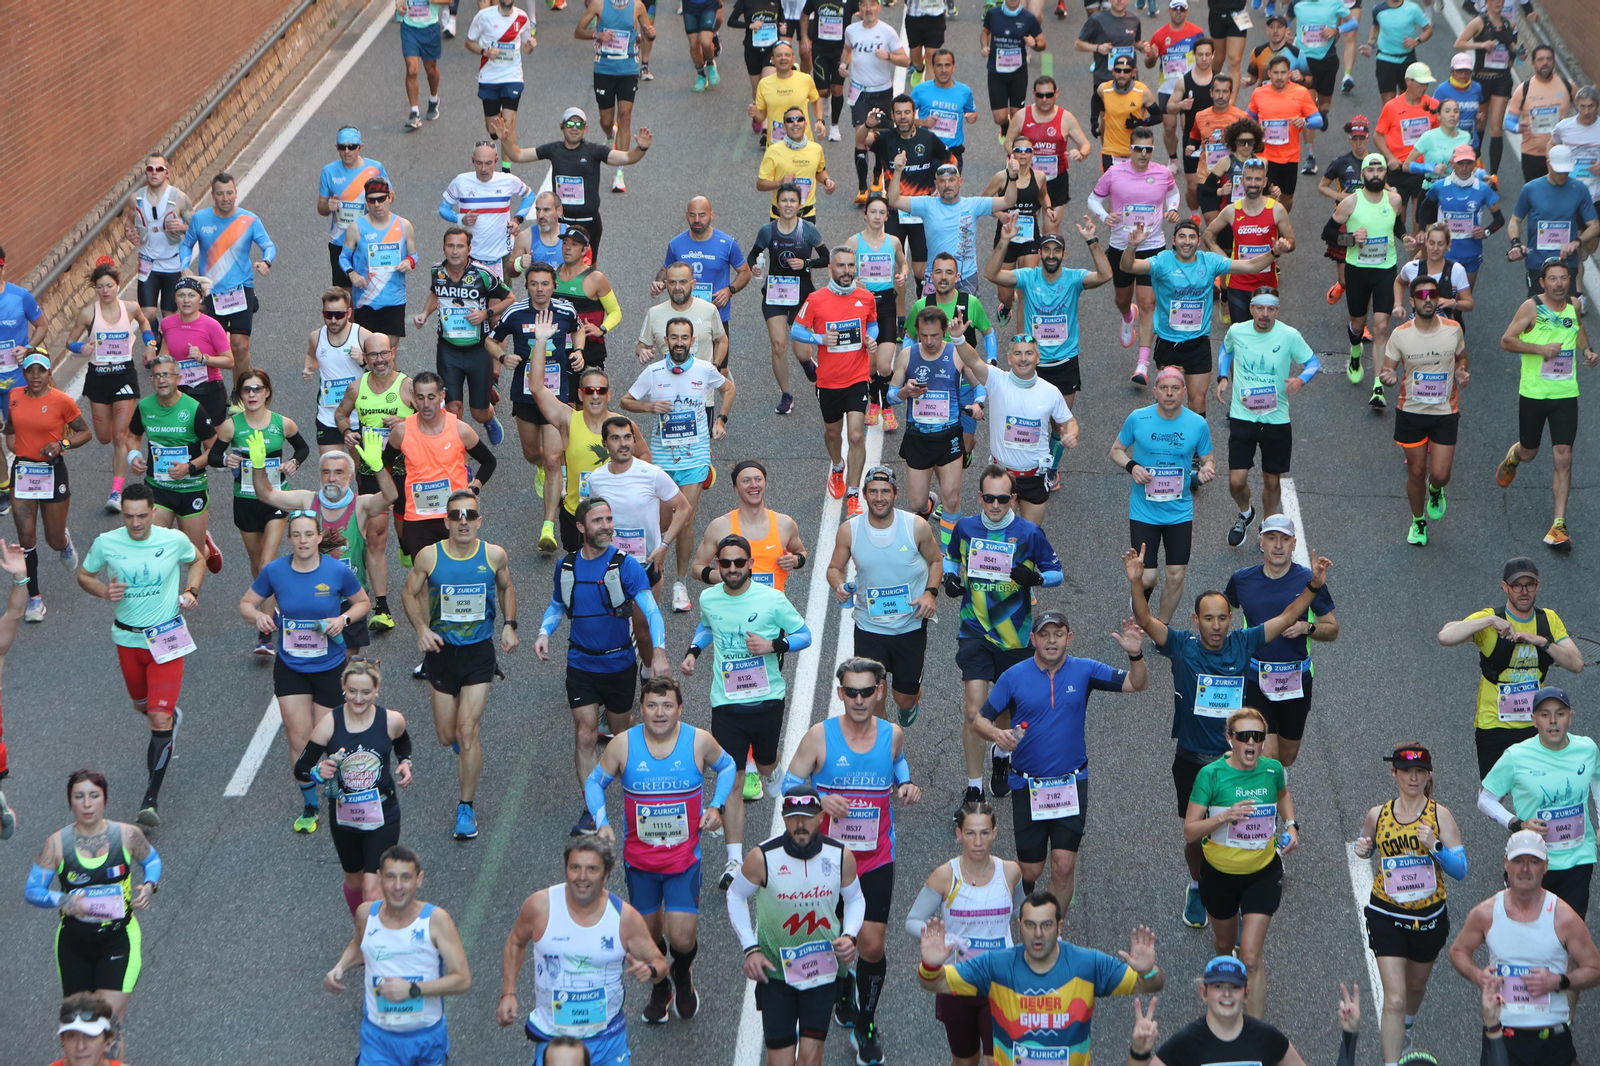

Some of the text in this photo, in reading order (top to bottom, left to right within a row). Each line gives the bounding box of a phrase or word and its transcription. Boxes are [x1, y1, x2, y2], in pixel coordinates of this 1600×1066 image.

[932, 100, 958, 111] PERU
[1237, 227, 1262, 235] OZONO
[691, 261, 703, 273] 10
[435, 286, 479, 299] HARIBO
[838, 321, 858, 329] ZURICH
[1252, 387, 1273, 395] ZURICH
[672, 413, 692, 421] ZURICH
[1018, 417, 1040, 426] ZURICH
[424, 482, 446, 490] ZURICH
[985, 542, 1008, 551] ZURICH
[983, 556, 997, 564] 8541
[979, 564, 1002, 572] ROSENDO
[881, 588, 904, 596] ZURICH
[735, 660, 759, 669] ZURICH
[1213, 692, 1227, 700] 5923
[632, 780, 690, 791] CREDUS
[834, 776, 886, 786] CREDUS
[1046, 777, 1070, 786] ZURICH
[1046, 792, 1061, 800] 7182
[1235, 788, 1268, 797] RUNNER
[347, 793, 374, 803] ZURICH
[653, 806, 680, 815] ZURICH
[847, 810, 874, 818] ZURICH
[1554, 807, 1580, 817] ZURICH
[1245, 823, 1260, 831] 8312
[1555, 823, 1571, 832] 6842
[644, 830, 668, 838] ANTONIO
[1558, 832, 1571, 841] JAVI
[1382, 834, 1420, 857] COMO
[1398, 858, 1426, 867] ZURICH
[1400, 873, 1416, 882] 8357
[1395, 882, 1425, 892] MARMALU
[777, 886, 833, 901] maratón
[974, 940, 1001, 948] ZURICH
[798, 944, 826, 955] ZURICH
[570, 991, 600, 1001] ZURICH
[1513, 995, 1530, 1003] SEAN
[1019, 996, 1062, 1011] NEVER
[1019, 1012, 1070, 1029] GIVE UP
[1030, 1050, 1060, 1059] ZURICH
